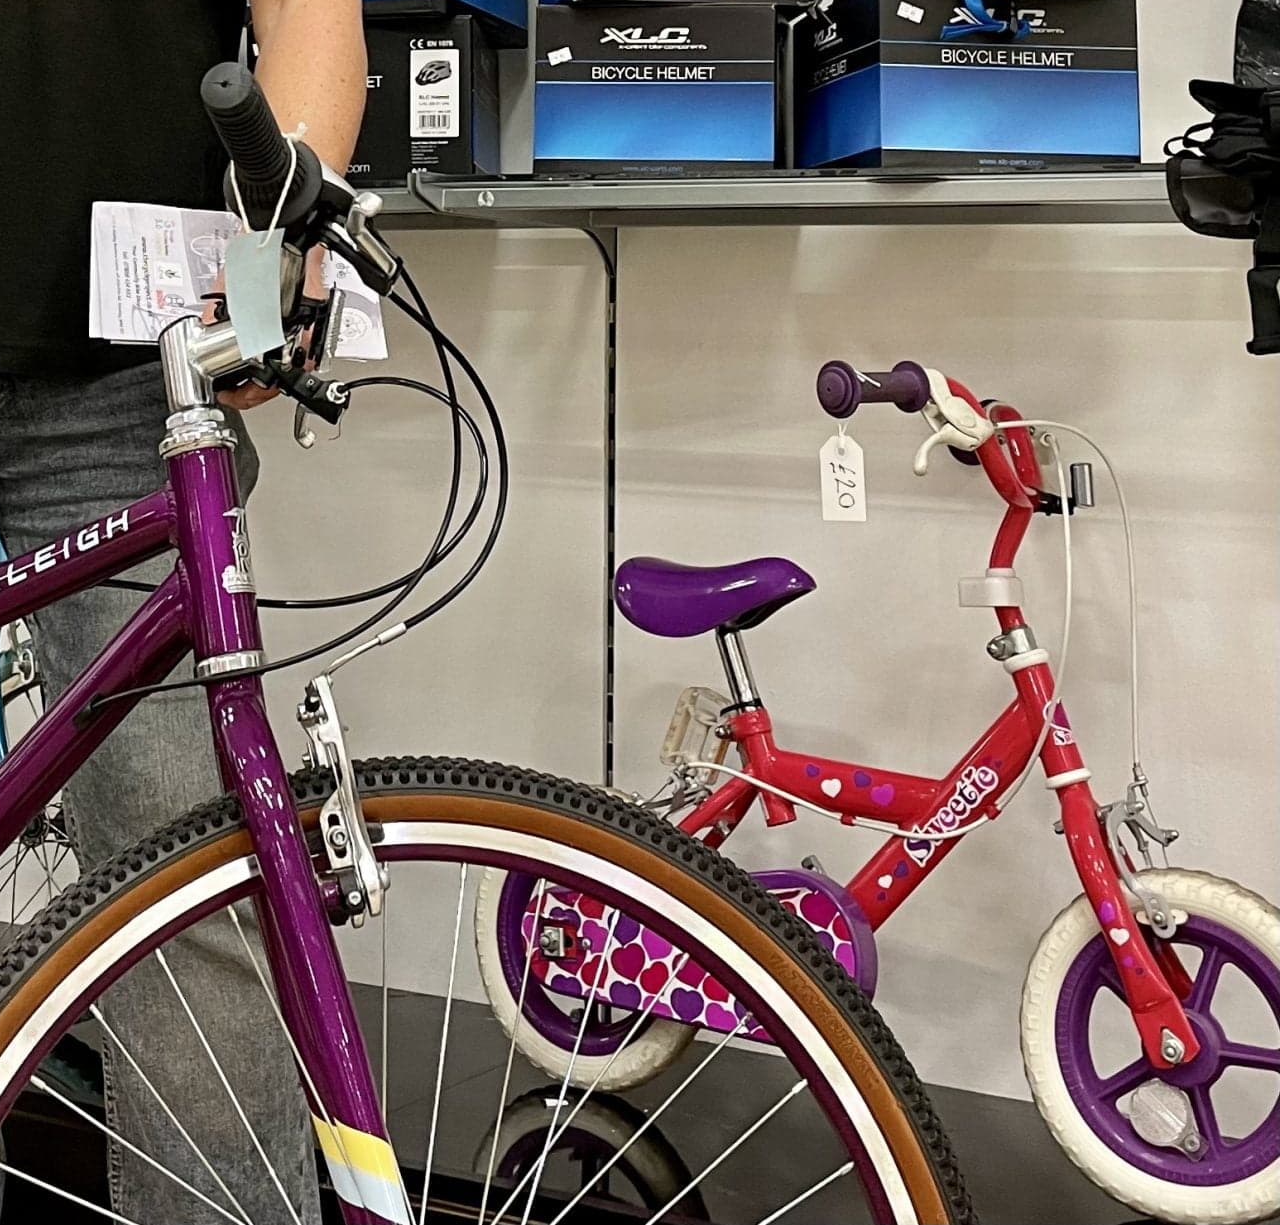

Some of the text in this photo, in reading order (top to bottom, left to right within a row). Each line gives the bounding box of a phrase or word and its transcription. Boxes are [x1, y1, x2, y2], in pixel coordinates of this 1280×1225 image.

[600, 27, 690, 43] XLC
[941, 48, 1075, 67] BICYCLE HELMET
[591, 66, 716, 80] BICYCLE HELMET
[903, 764, 999, 866] Sweetie
